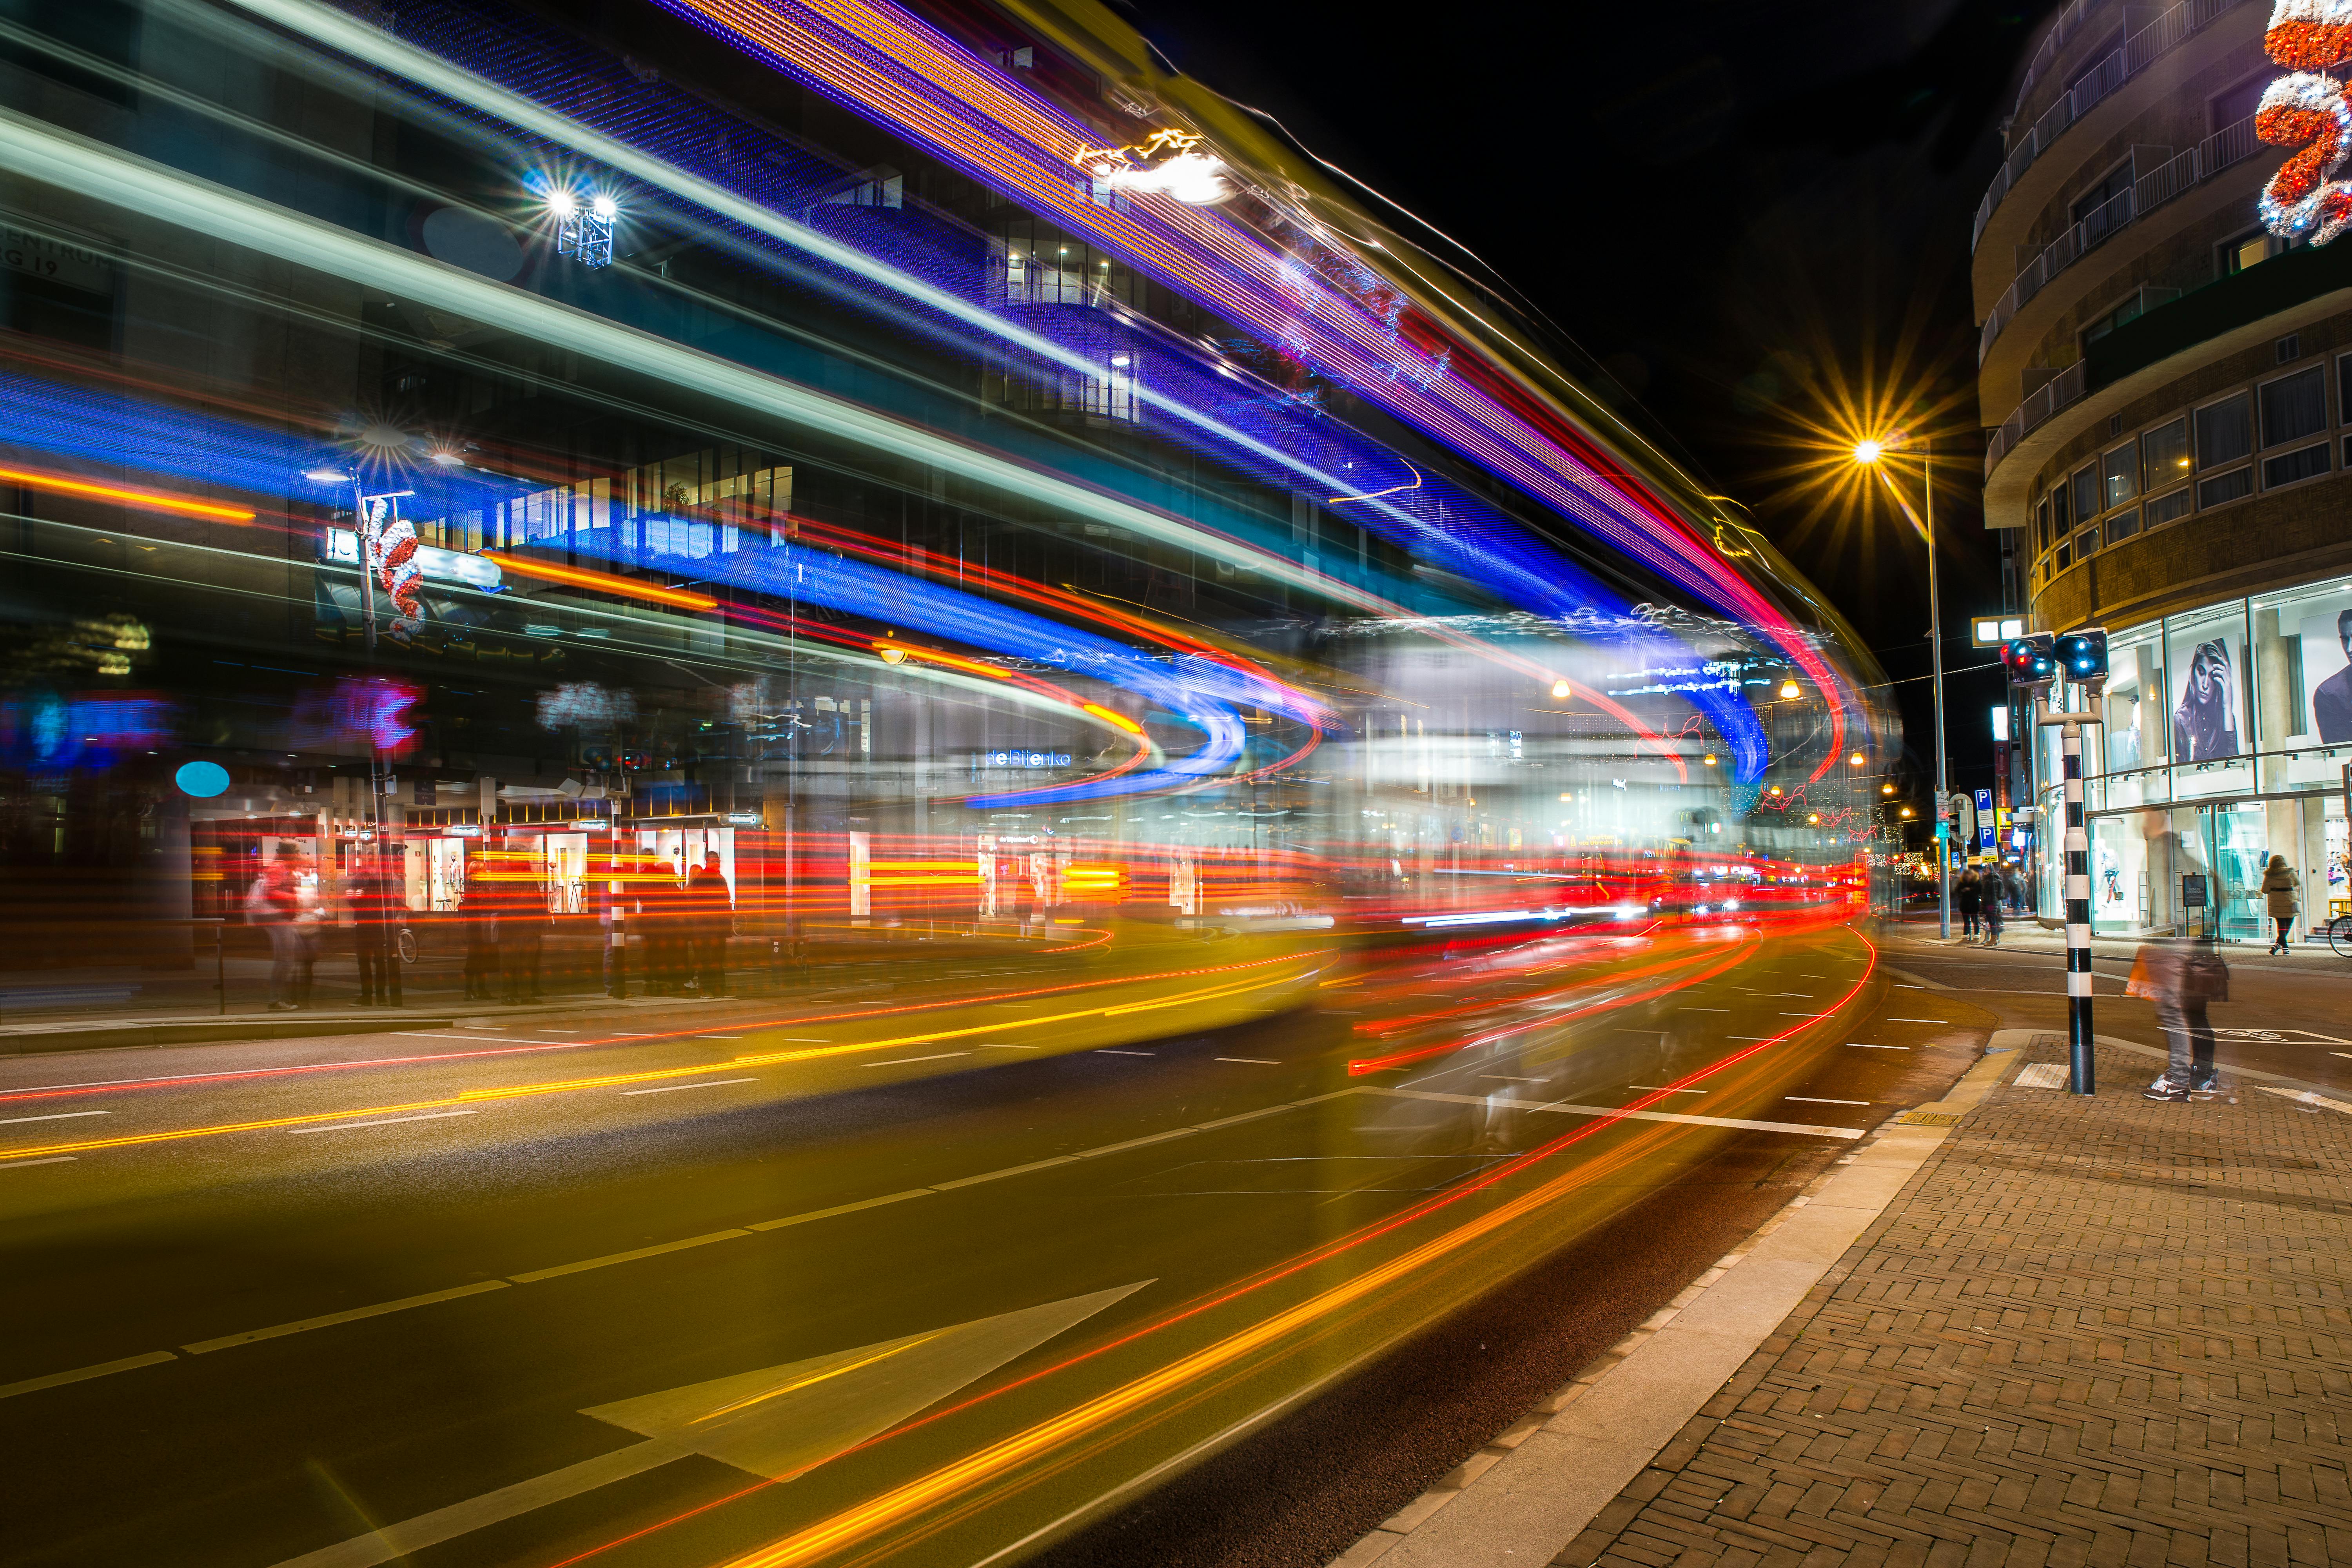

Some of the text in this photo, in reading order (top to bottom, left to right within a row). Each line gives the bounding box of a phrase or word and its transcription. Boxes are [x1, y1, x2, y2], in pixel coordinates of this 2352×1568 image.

[0, 229, 112, 270] ENTRUM
[35, 257, 57, 275] 19
[1979, 791, 1987, 802] P
[1983, 828, 1992, 839] P
